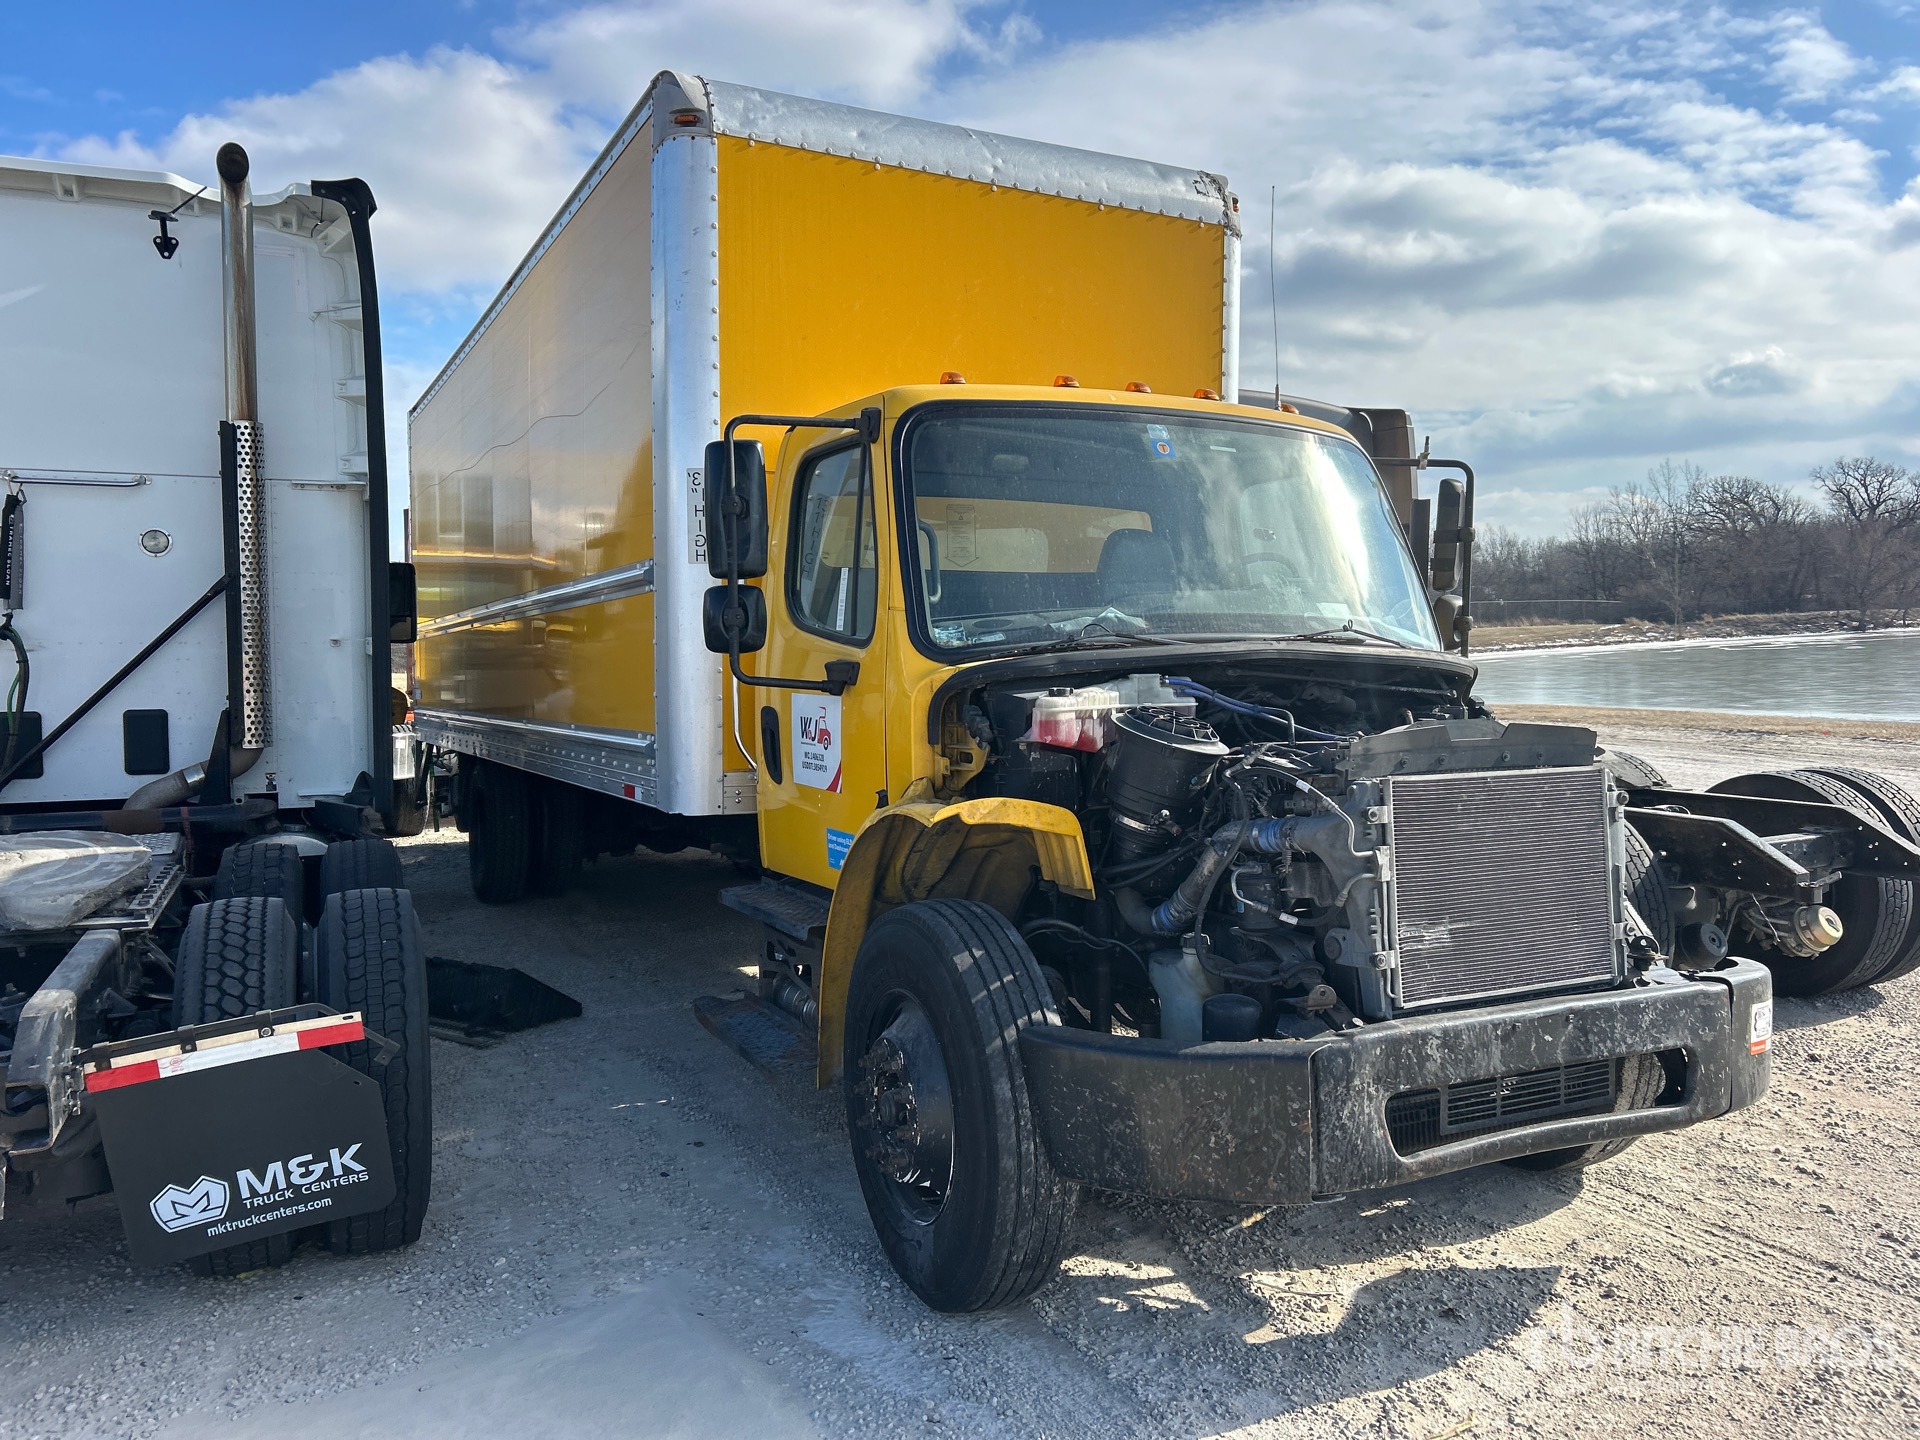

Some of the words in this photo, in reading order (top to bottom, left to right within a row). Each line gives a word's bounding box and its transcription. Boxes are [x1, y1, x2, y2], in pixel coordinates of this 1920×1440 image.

[236, 1142, 367, 1199] M&K
[243, 1188, 295, 1209] TRUCK
[301, 1171, 369, 1194] CENTERS
[207, 1197, 333, 1237] mktruckcenters.com
